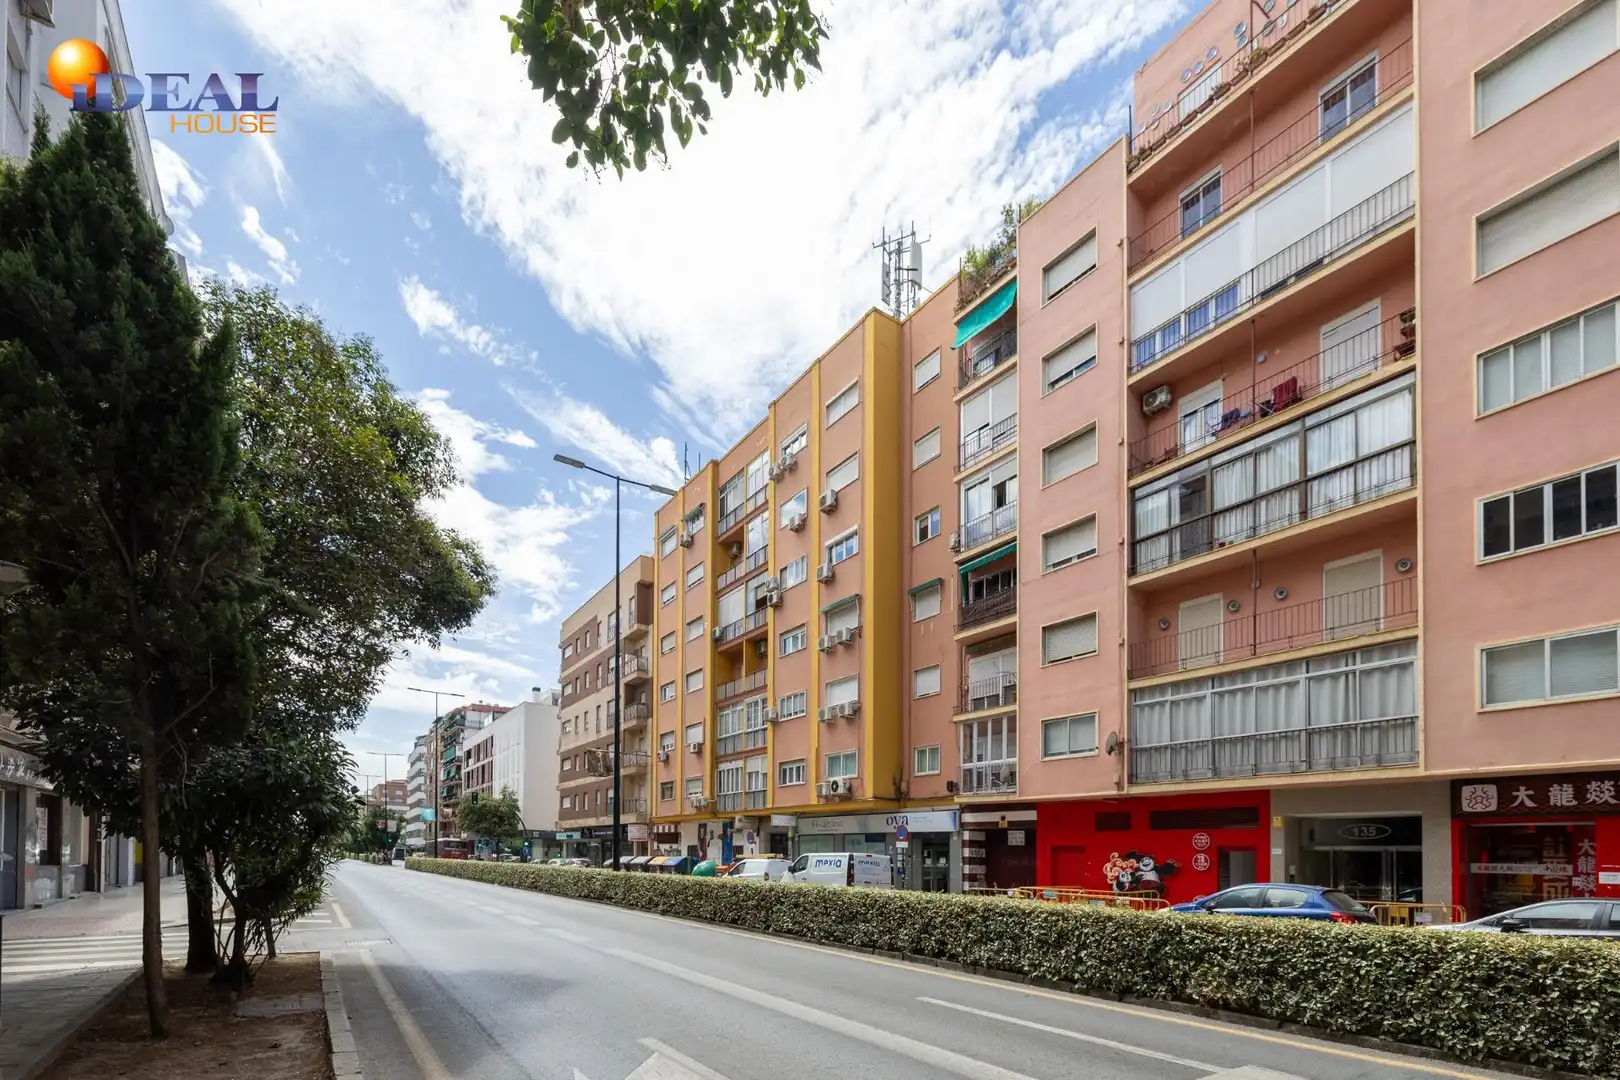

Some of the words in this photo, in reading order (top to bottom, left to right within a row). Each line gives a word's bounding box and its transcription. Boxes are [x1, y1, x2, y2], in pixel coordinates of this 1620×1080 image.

[1351, 826, 1376, 837] 135
[1574, 838, 1597, 898] 大龍燚
